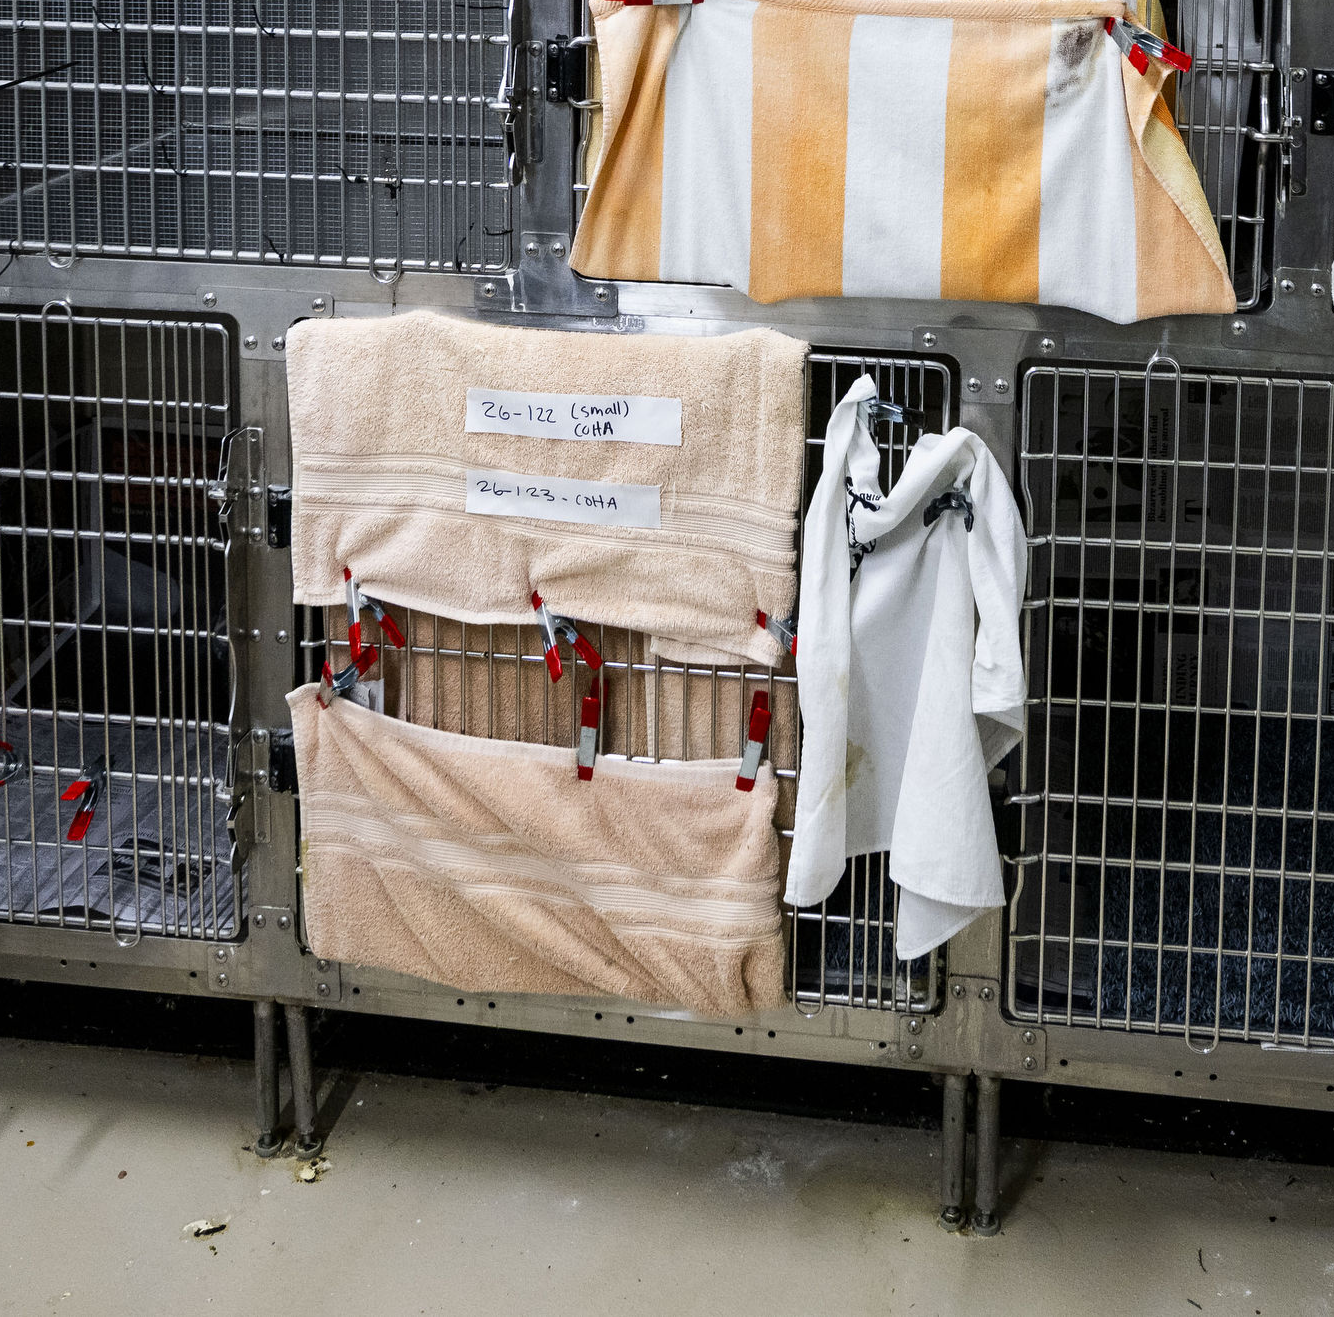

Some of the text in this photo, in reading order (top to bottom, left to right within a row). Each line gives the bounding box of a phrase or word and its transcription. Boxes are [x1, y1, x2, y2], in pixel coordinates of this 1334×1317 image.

[481, 400, 630, 424] 26-122 (small)
[476, 480, 555, 502] 26-123
[575, 494, 618, 510] COHA
[1175, 654, 1188, 706] INDING
